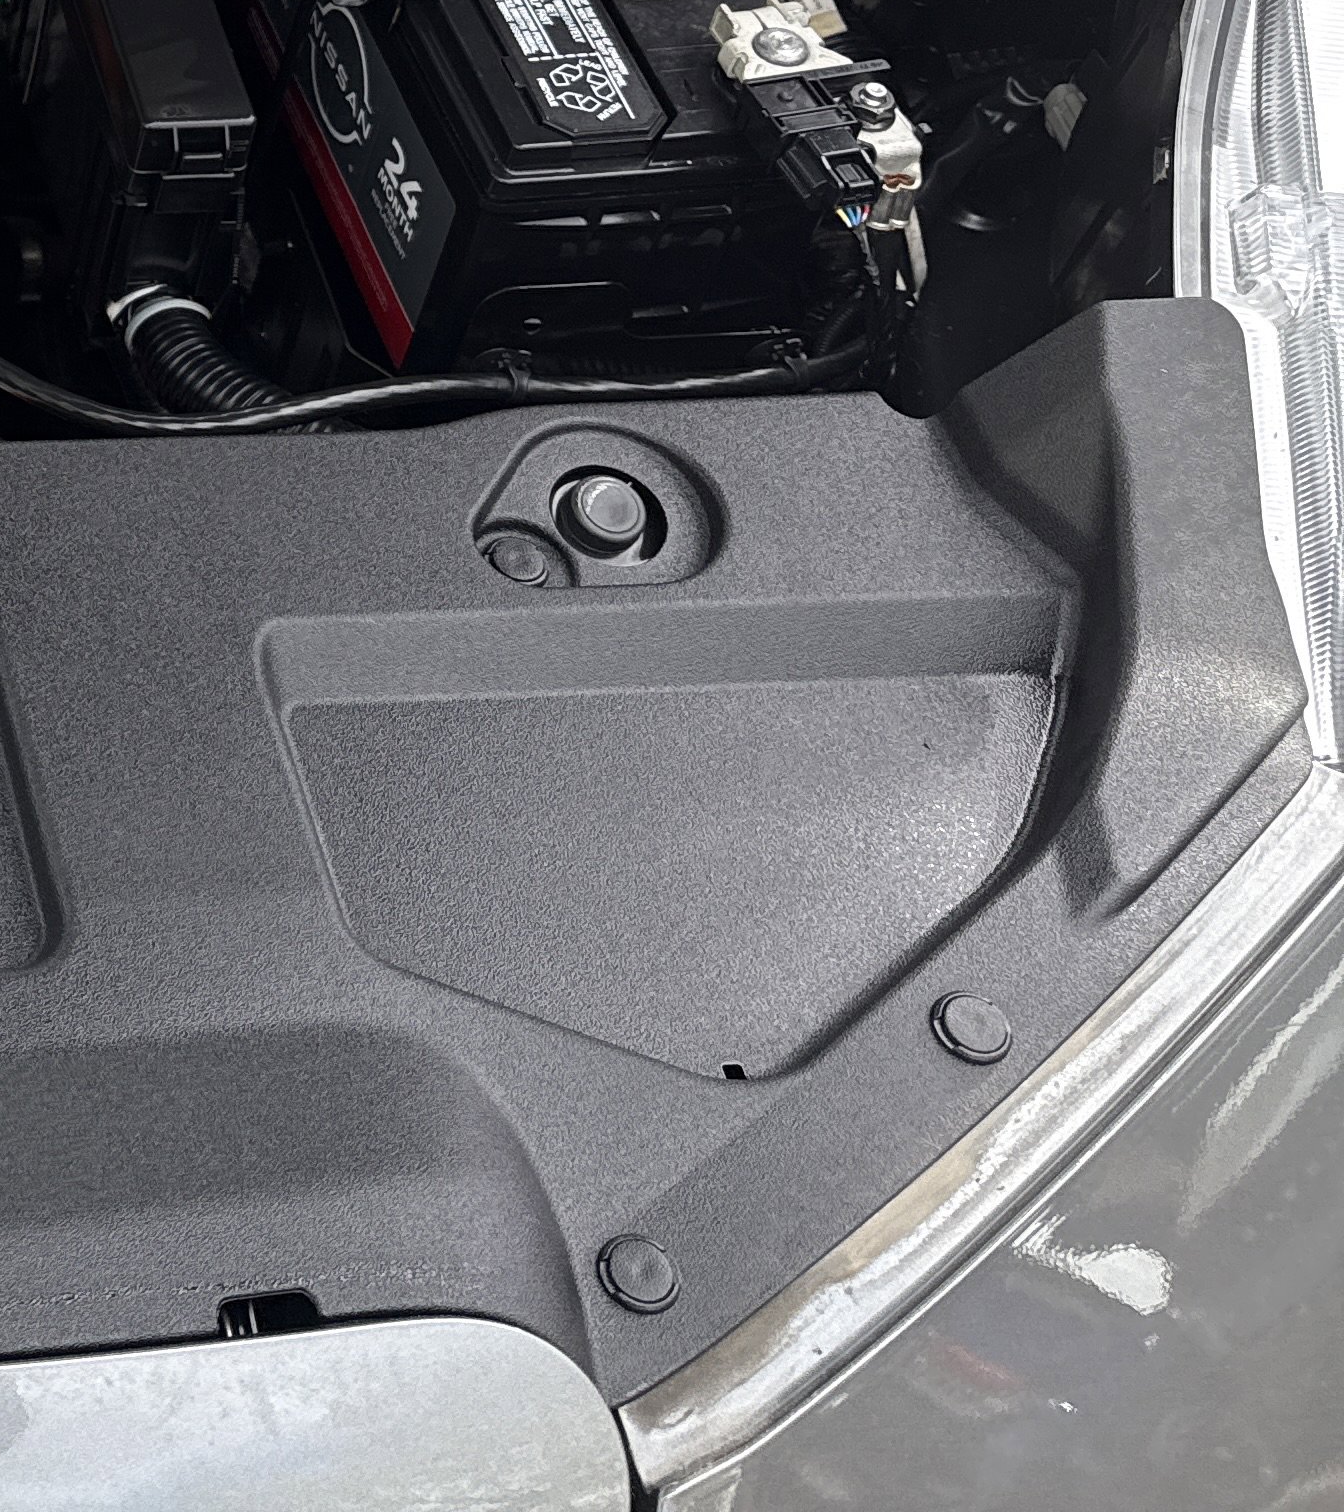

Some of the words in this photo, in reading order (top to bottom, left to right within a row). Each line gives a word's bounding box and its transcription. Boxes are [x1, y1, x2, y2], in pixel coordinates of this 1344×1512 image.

[310, 8, 372, 140] NISSAN
[377, 167, 415, 243] MONTH
[383, 137, 422, 221] 24
